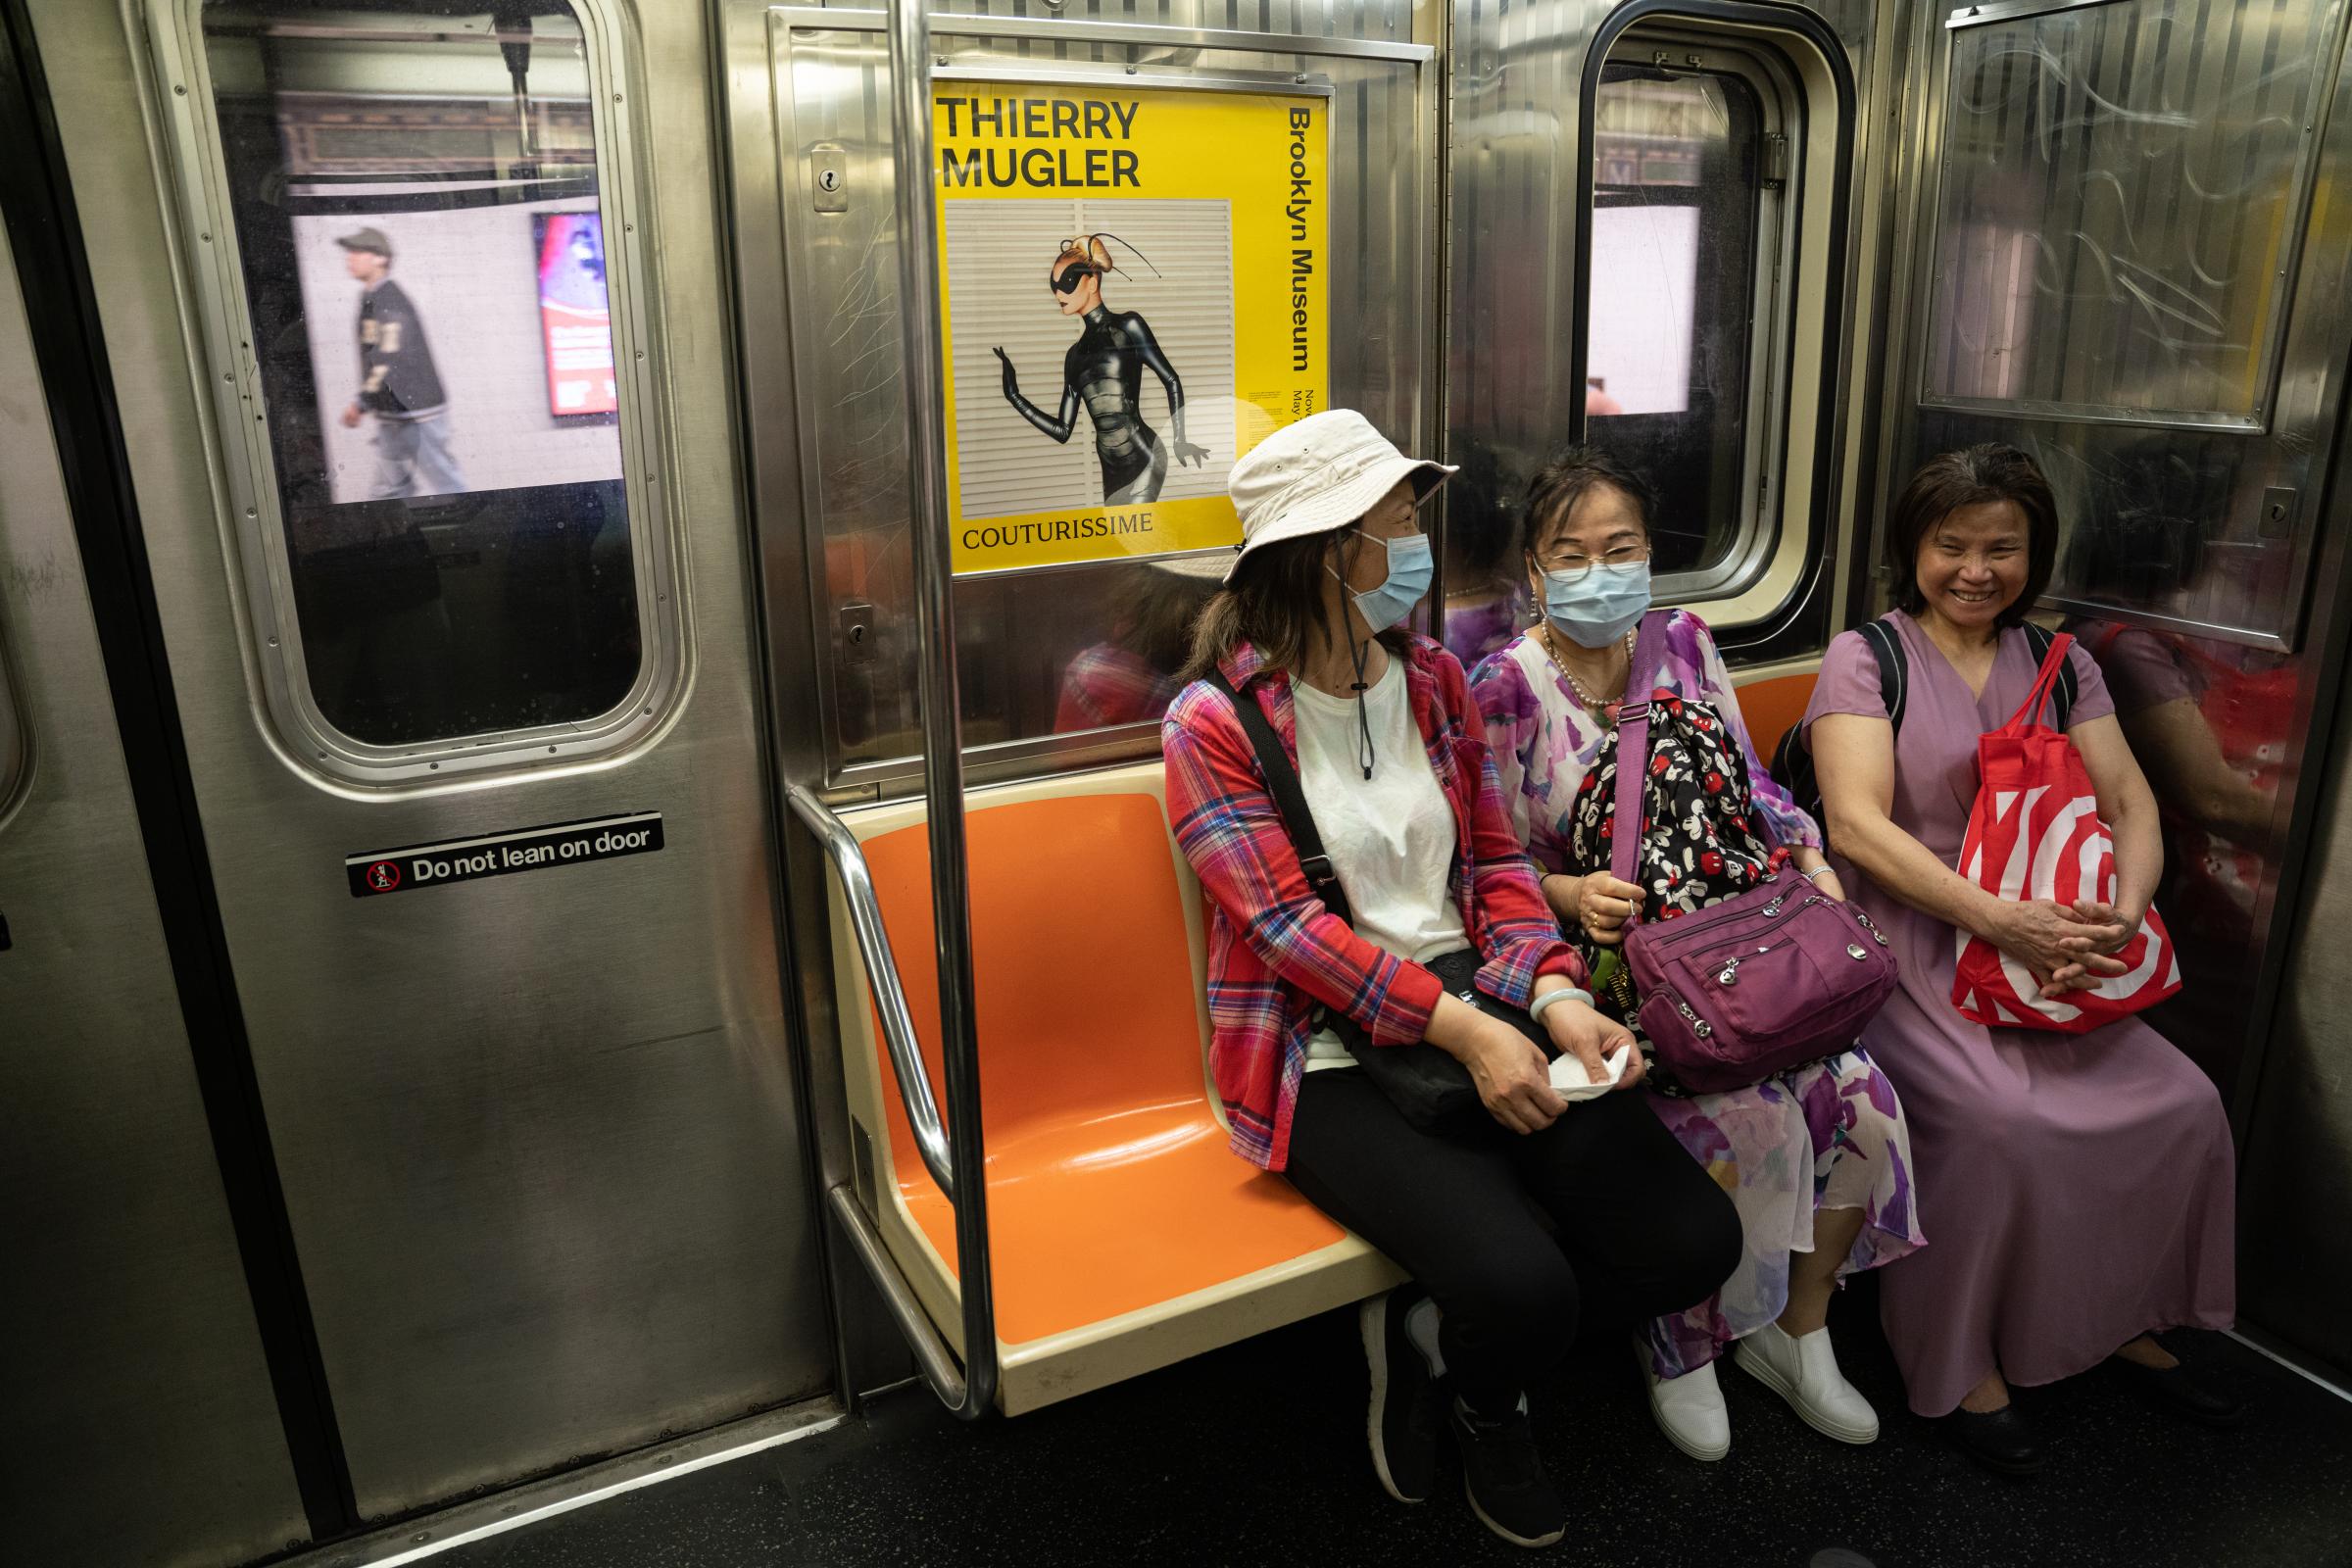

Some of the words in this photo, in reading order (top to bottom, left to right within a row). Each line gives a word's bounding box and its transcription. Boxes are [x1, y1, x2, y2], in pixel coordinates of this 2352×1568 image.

[936, 97, 1140, 140] THIERRY
[942, 148, 1141, 188] MUGLER
[1286, 107, 1311, 242] Brooklyn
[1292, 249, 1313, 371] Museum
[1292, 390, 1302, 415] May
[962, 513, 1153, 550] COUTURISSIME
[413, 858, 450, 882] Do
[454, 850, 497, 873] not
[503, 844, 555, 867] lean
[560, 840, 590, 858] on
[595, 830, 651, 854] door
